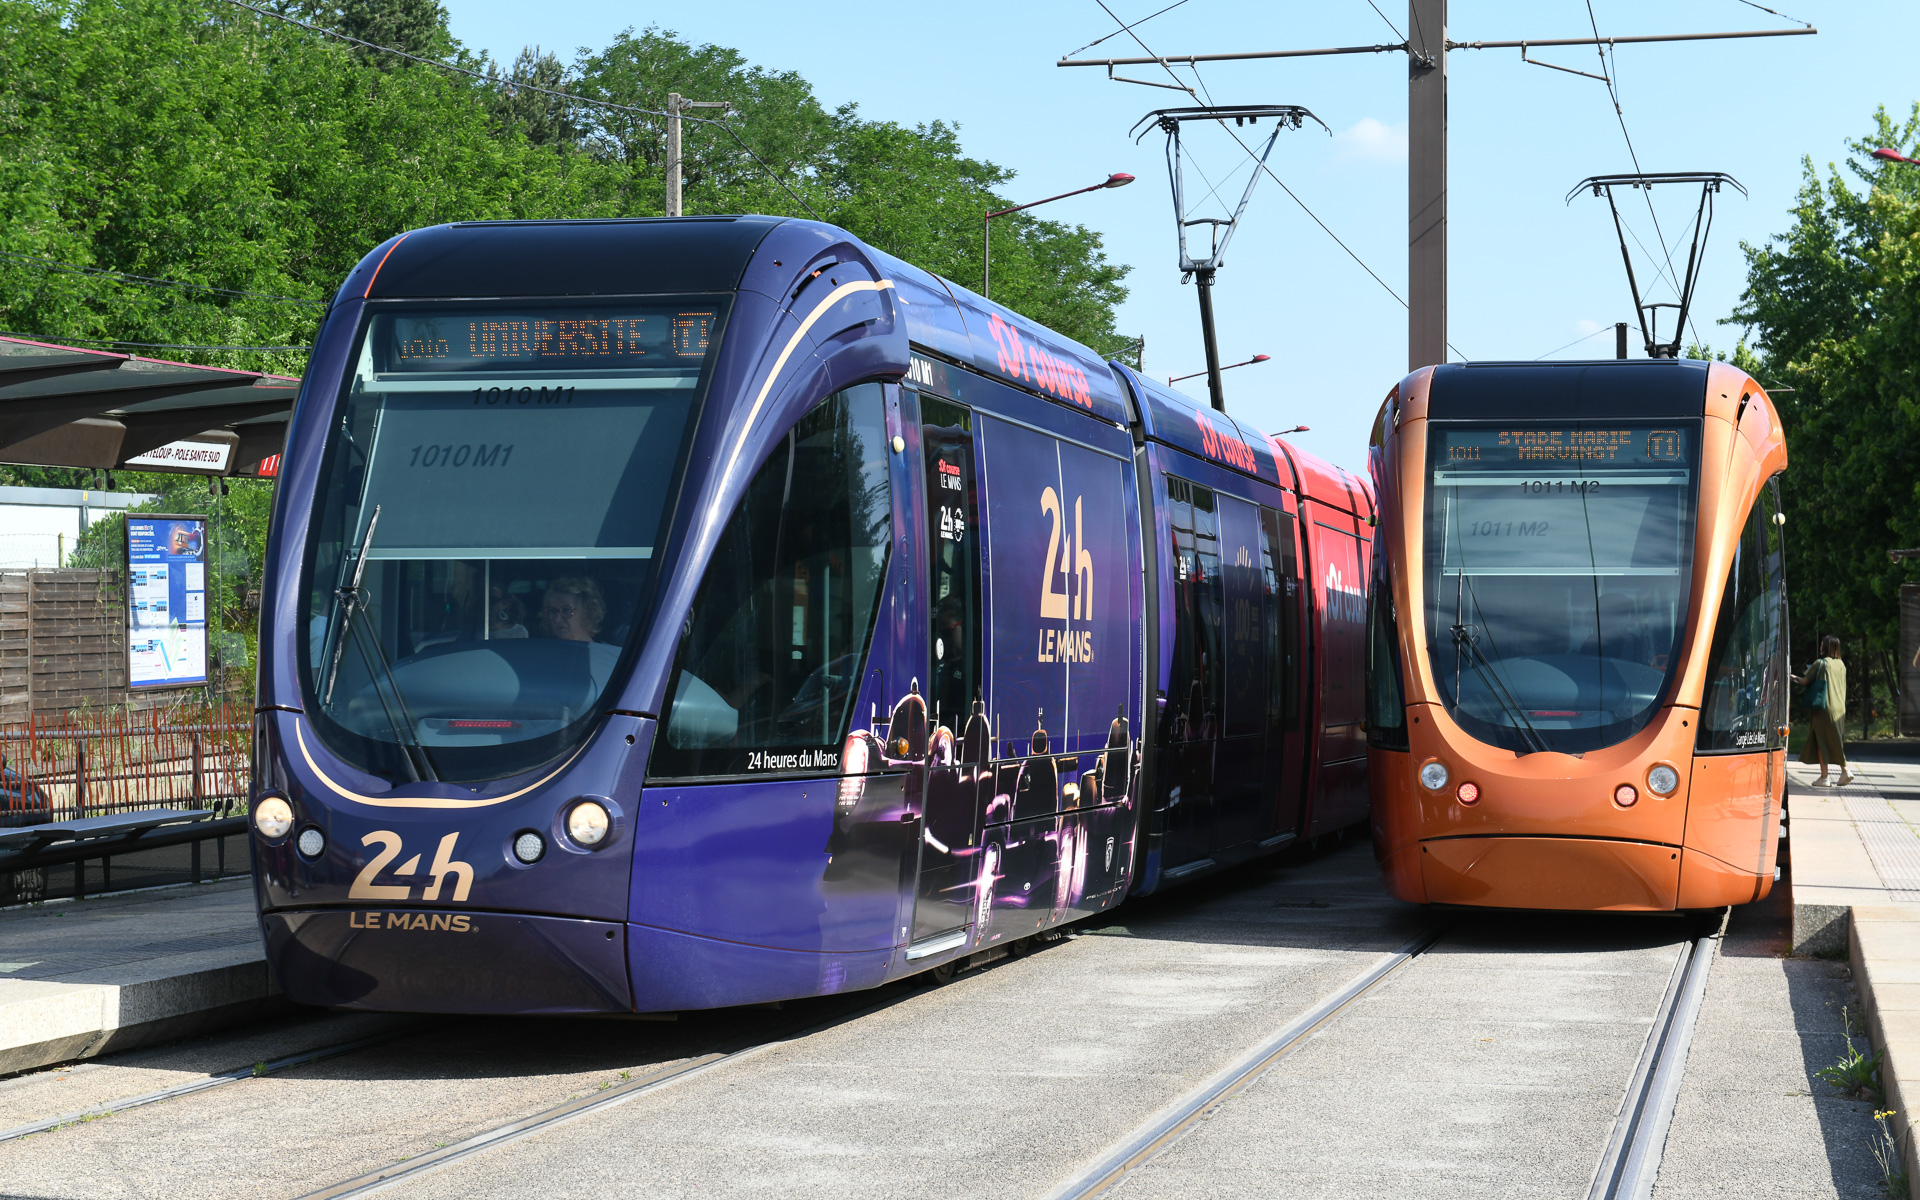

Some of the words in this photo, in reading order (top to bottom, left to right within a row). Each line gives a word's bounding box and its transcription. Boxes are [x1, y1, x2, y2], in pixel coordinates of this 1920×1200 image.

[469, 319, 646, 357] UNIVERSITE
[905, 356, 921, 382] 010
[1029, 345, 1093, 409] course
[473, 386, 533, 405] 1010
[538, 385, 576, 405] M1
[1498, 431, 1563, 445] STADE
[1570, 431, 1632, 445] MARIE
[1651, 436, 1675, 456] T1
[207, 450, 221, 462] SUD
[409, 444, 472, 467] 1010
[471, 444, 515, 467] M1
[1218, 431, 1257, 474] course
[1448, 446, 1481, 460] 1011
[940, 473, 947, 489] LE
[1520, 480, 1563, 494] 1011
[1570, 480, 1600, 494] M2
[1471, 521, 1513, 537] 1011
[1518, 521, 1549, 537] M2
[1041, 486, 1093, 621] 24h
[1038, 629, 1055, 663] LE
[1055, 630, 1092, 663] MANS
[747, 752, 761, 770] 24
[763, 750, 798, 769] heures
[799, 749, 812, 768] du
[813, 749, 838, 767] Mans
[348, 829, 474, 902] 24h
[349, 911, 381, 929] LE
[386, 912, 471, 932] MANS
